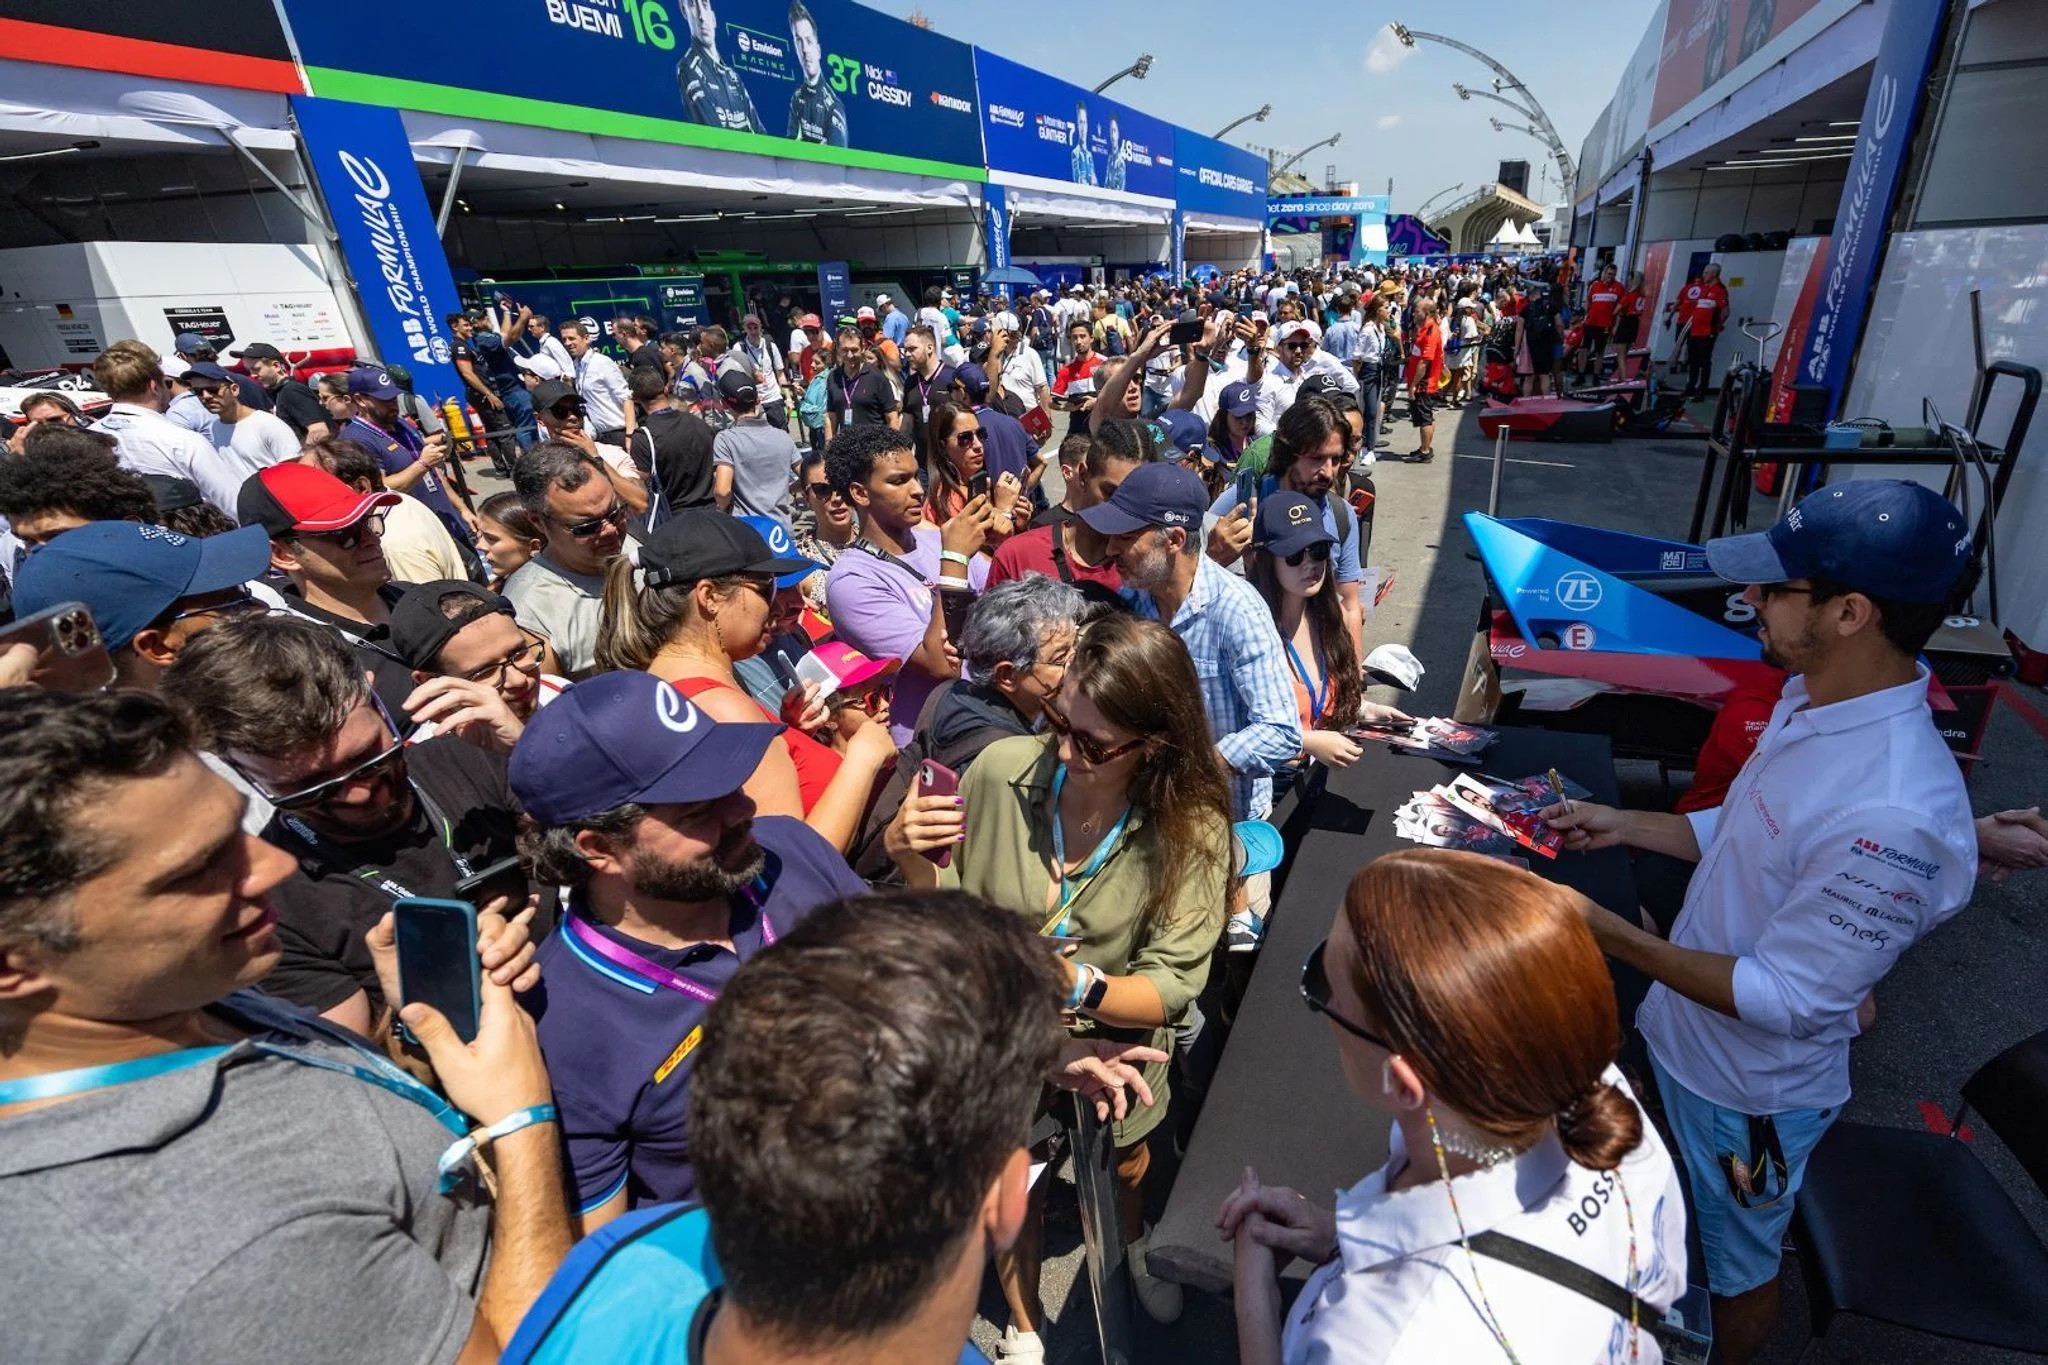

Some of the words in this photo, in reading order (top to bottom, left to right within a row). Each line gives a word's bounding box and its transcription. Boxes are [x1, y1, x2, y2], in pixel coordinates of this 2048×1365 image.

[546, 0, 624, 39] BUEMI
[622, 0, 676, 50] 16
[752, 39, 783, 57] Envision
[741, 54, 785, 71] RACING
[827, 53, 861, 95] 37
[865, 64, 884, 81] Nick
[868, 82, 912, 107] CASSIDY
[1066, 121, 1076, 146] 7
[1120, 139, 1133, 162] 48
[1199, 167, 1223, 188] OFFICIAL
[1223, 173, 1237, 191] CARS
[1237, 177, 1254, 195] GARAGE
[1281, 203, 1304, 212] zero
[1304, 201, 1331, 212] since
[1332, 201, 1351, 211] day
[1352, 201, 1375, 210] zero
[355, 193, 421, 317] FORMULA
[388, 203, 424, 293] CHAMPIONSHIP
[1808, 313, 1831, 380] ABB
[1826, 138, 1878, 311] FORMULA
[418, 296, 438, 334] WORLD
[402, 318, 435, 365] ABB
[433, 337, 451, 364] FIA
[58, 374, 92, 392] 94
[1540, 594, 1550, 602] by
[1571, 628, 1587, 648] E
[1855, 837, 1880, 853] ABB
[1878, 847, 1930, 873] FORMULA
[1821, 887, 1862, 911] MAURICE
[1566, 1170, 1616, 1237] BOSS
